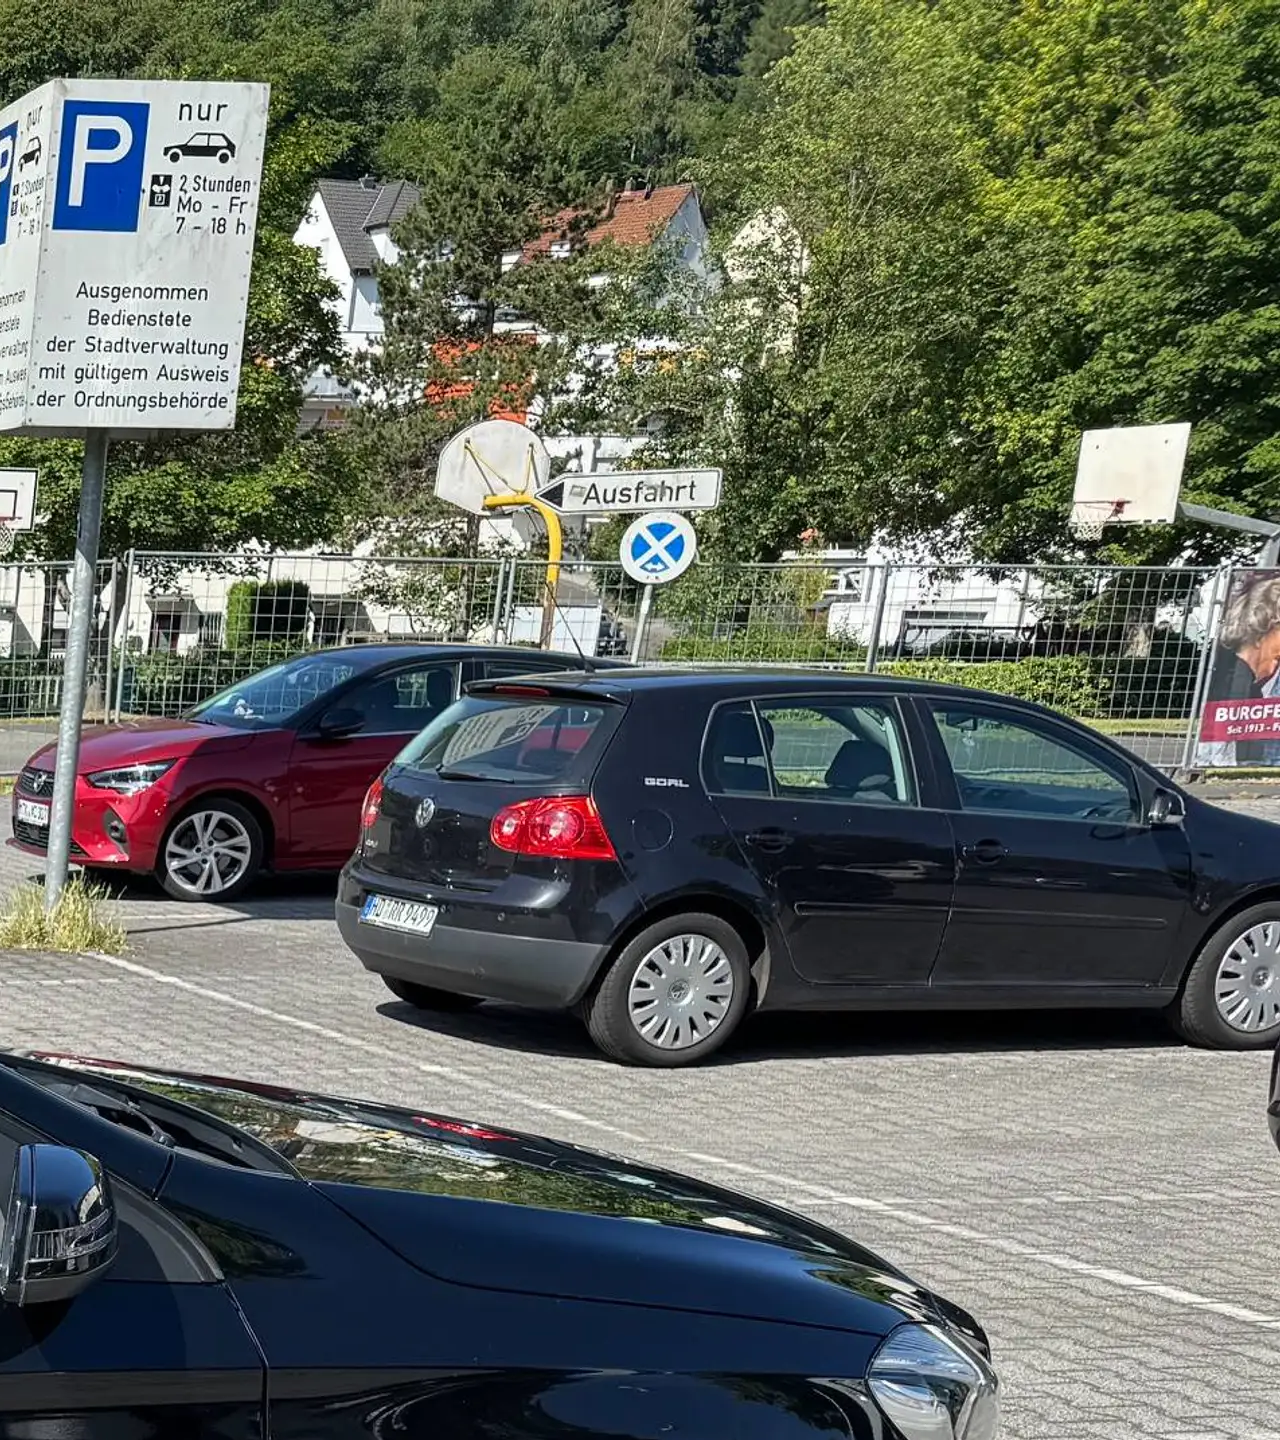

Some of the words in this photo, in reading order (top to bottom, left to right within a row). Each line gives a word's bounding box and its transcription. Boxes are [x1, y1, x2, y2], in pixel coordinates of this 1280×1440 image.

[179, 103, 228, 121] nur
[68, 115, 134, 207] P
[180, 174, 188, 193] 2
[192, 175, 251, 193] Stunden
[177, 196, 202, 213] Mo
[229, 196, 248, 214] Fr
[176, 216, 185, 234] 7
[211, 217, 227, 234] 18
[236, 218, 246, 235] h
[76, 281, 208, 303] Ausgenommen
[88, 309, 192, 327] Bedienstete
[46, 336, 76, 352] der
[85, 336, 229, 360] Stadtverwaltung
[39, 362, 65, 380] mit
[75, 363, 148, 384] gültigem
[156, 364, 229, 382] Ausweis
[37, 391, 66, 407] der
[74, 391, 228, 412] Ordnungsbehörde
[583, 480, 696, 505] Ausfahrt
[1215, 704, 1280, 722] BURGFE
[1244, 723, 1265, 733] 1913
[644, 777, 690, 788] GOAL
